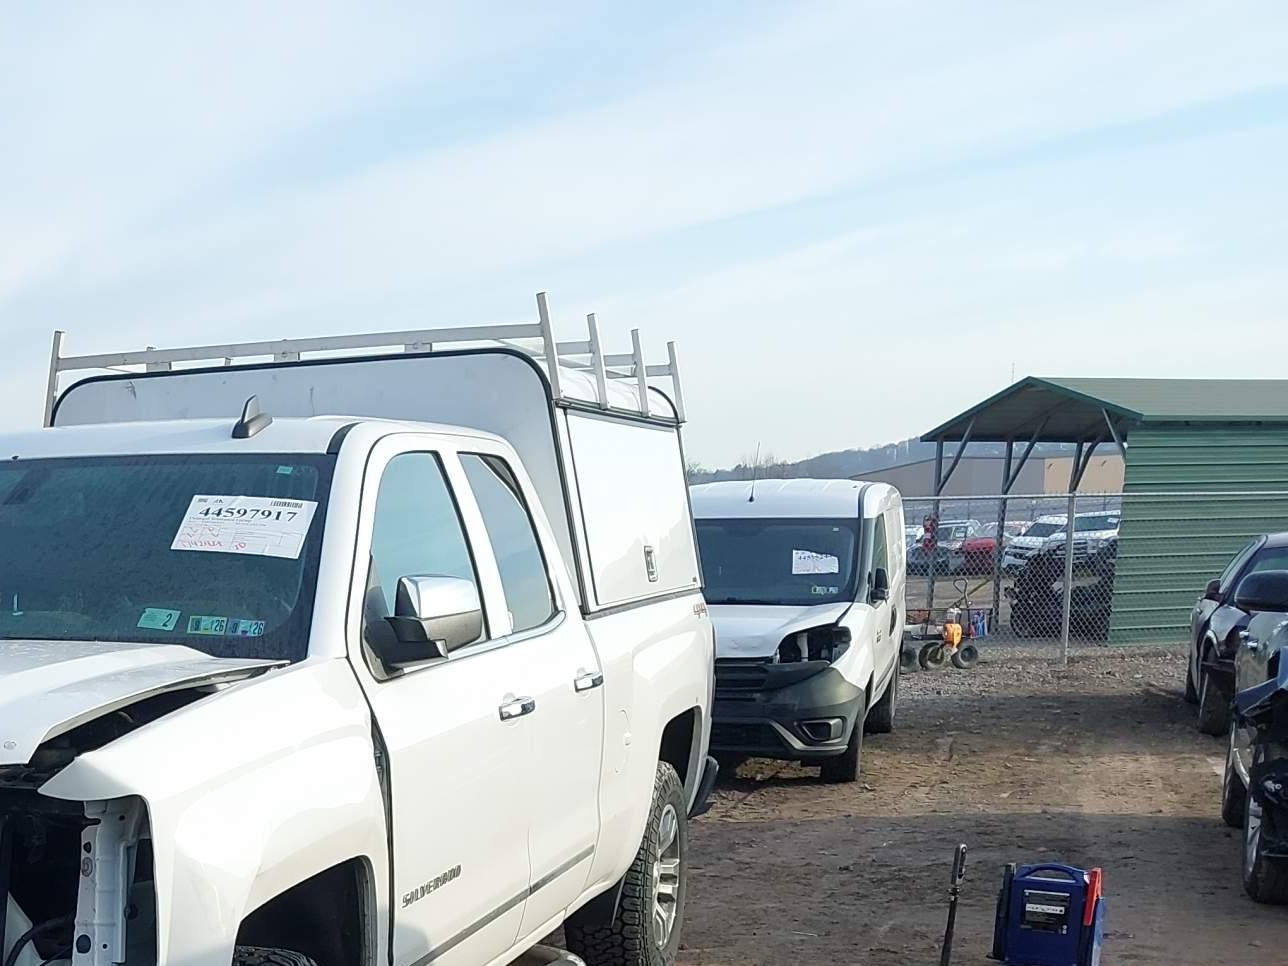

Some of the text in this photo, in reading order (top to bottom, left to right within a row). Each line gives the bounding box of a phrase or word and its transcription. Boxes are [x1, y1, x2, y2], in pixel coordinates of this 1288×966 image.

[199, 507, 298, 522] 44597917
[162, 613, 172, 627] 2
[402, 864, 461, 908] SILVERADO
